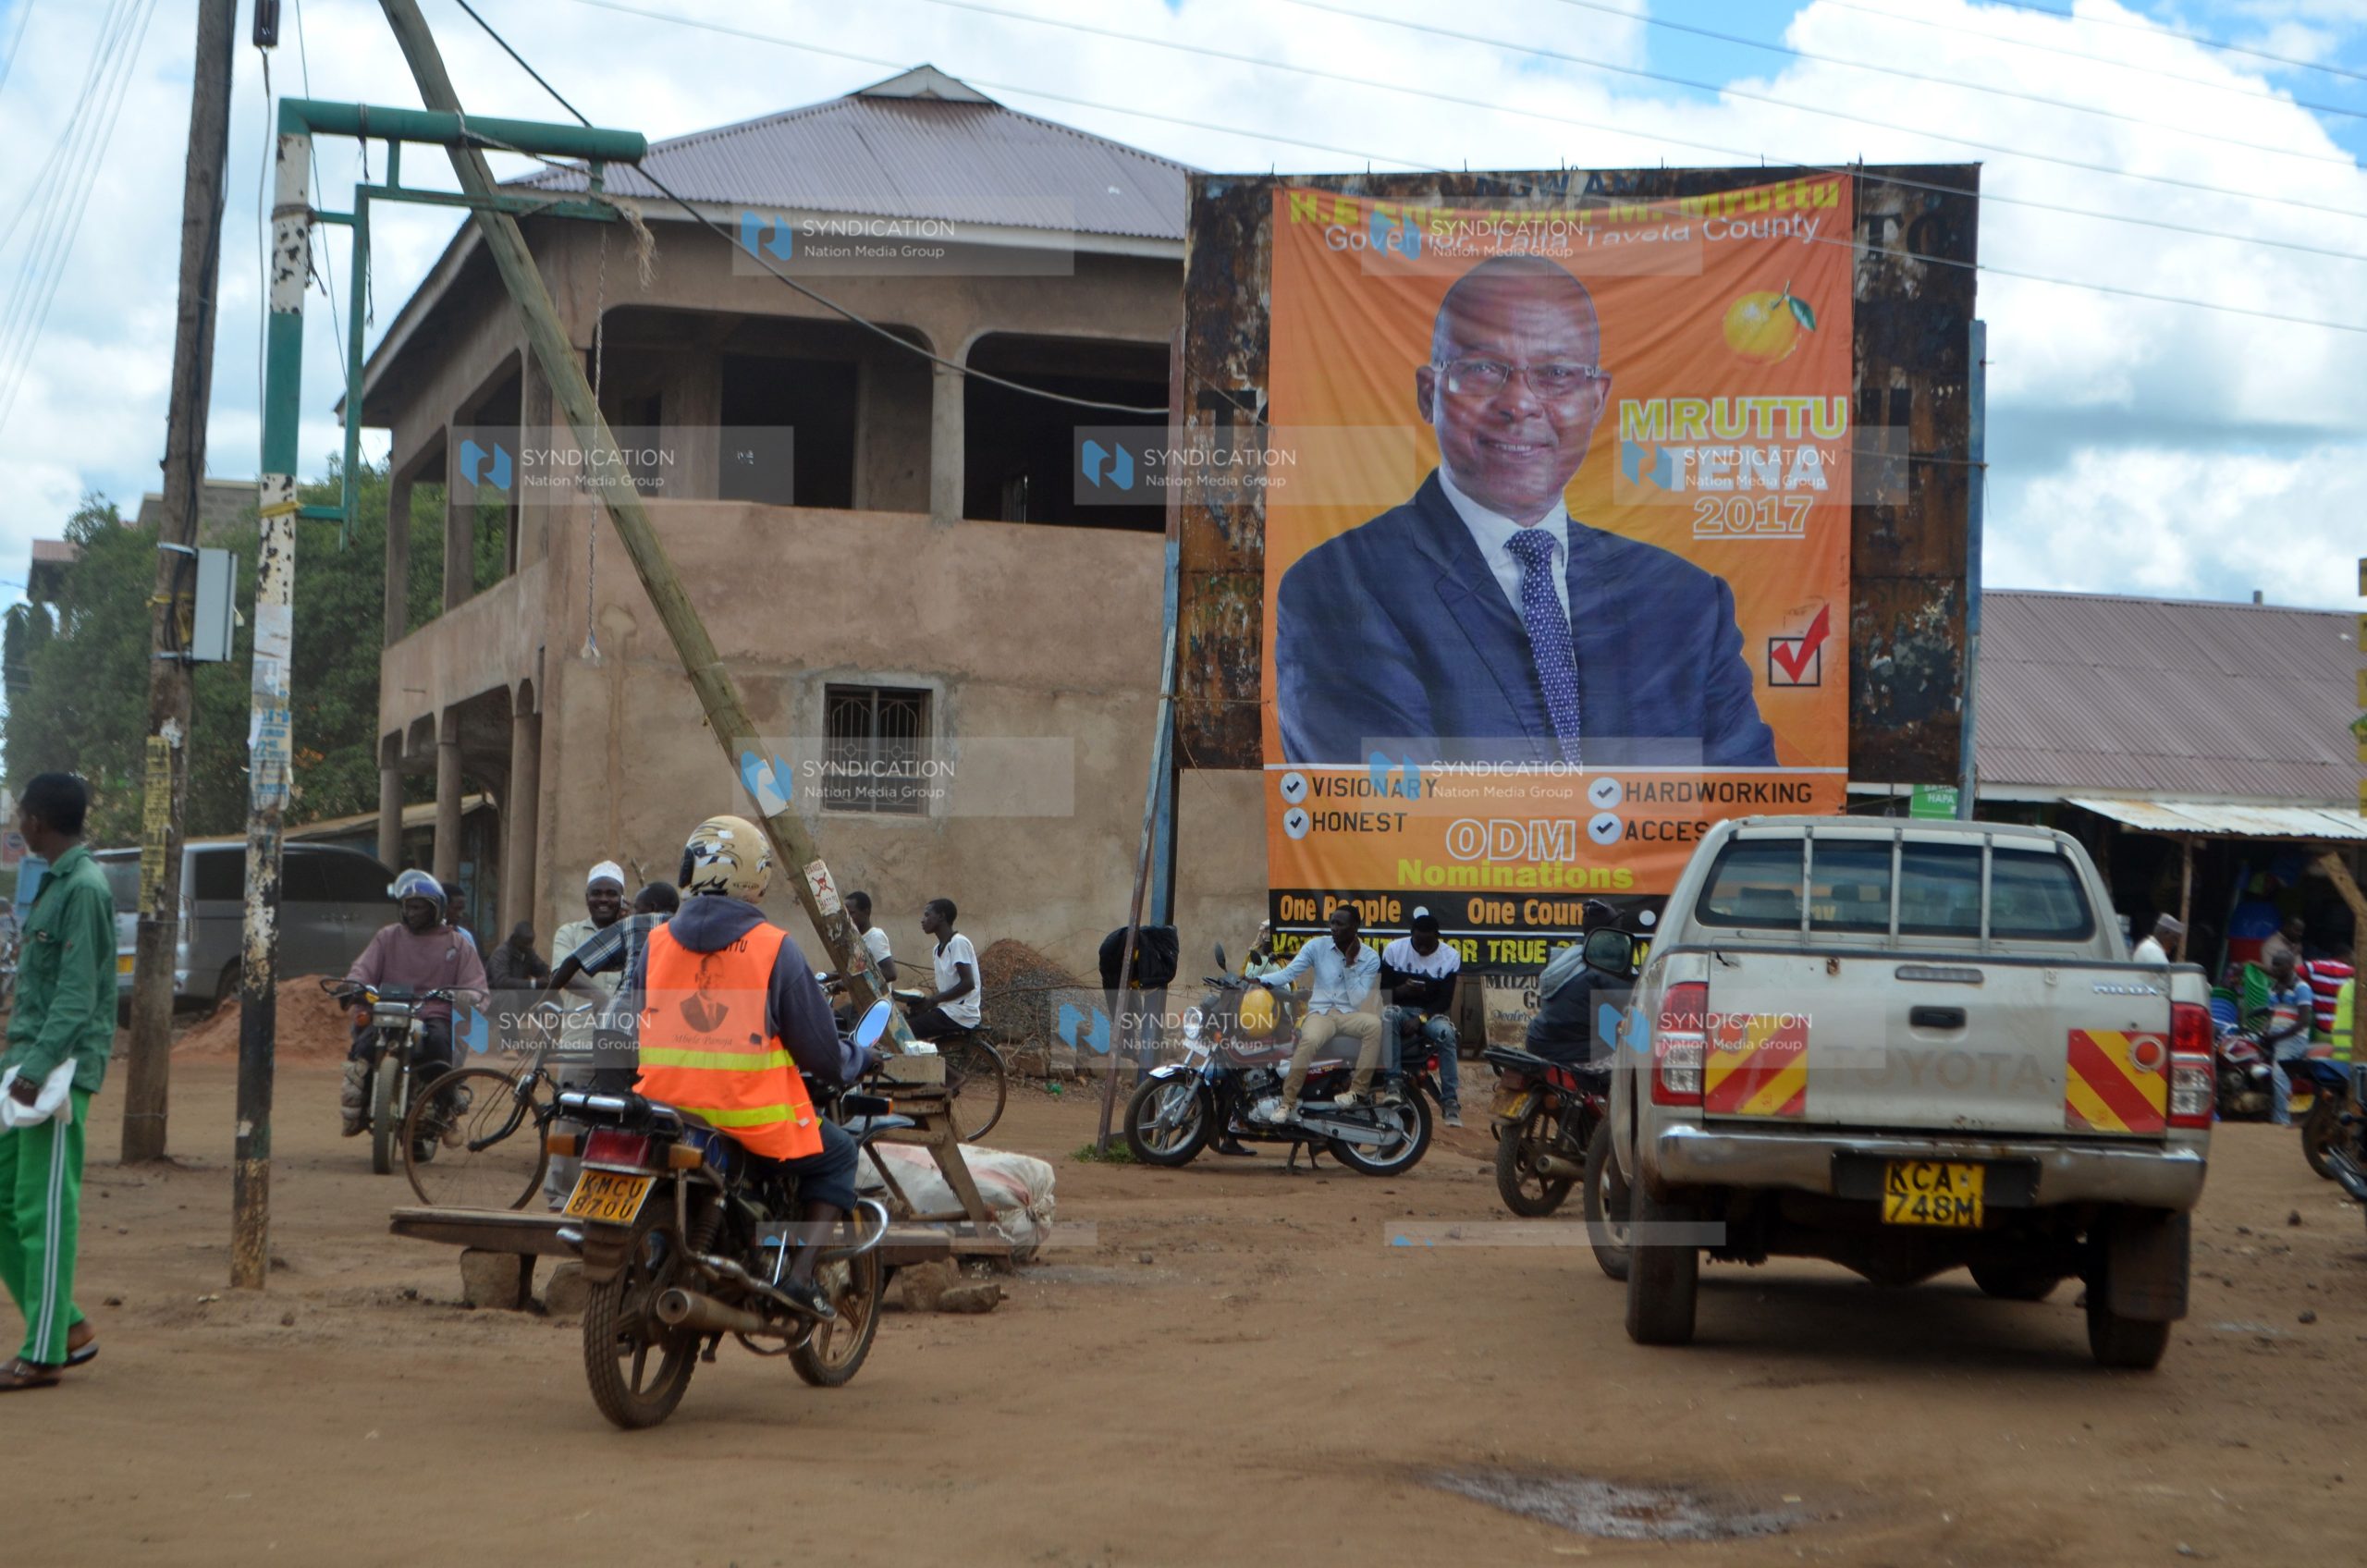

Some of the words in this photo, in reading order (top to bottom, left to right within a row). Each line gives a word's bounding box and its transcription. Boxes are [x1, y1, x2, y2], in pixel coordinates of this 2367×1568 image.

[1680, 179, 1838, 220] Mruttu
[1703, 213, 1820, 244] County
[1619, 396, 1847, 441] MRUTTU
[1664, 445, 1829, 492] TENA
[1693, 496, 1814, 533] 2017
[1313, 778, 1437, 799] VISIONARY
[1626, 781, 1811, 804] HARDWORKING
[1312, 812, 1408, 833] HONEST
[1445, 818, 1576, 862] ODM
[1397, 858, 1634, 888] Nominations
[1280, 896, 1317, 921] One
[1323, 895, 1402, 934] Pople
[1467, 897, 1515, 925] One
[1524, 898, 1584, 925] Coun
[1488, 939, 1547, 963] TRUE
[1823, 1046, 2049, 1095] TOYOTA
[581, 1173, 644, 1199] KMCU
[1887, 1164, 1953, 1191] KCA
[1889, 1194, 1975, 1220] 748M
